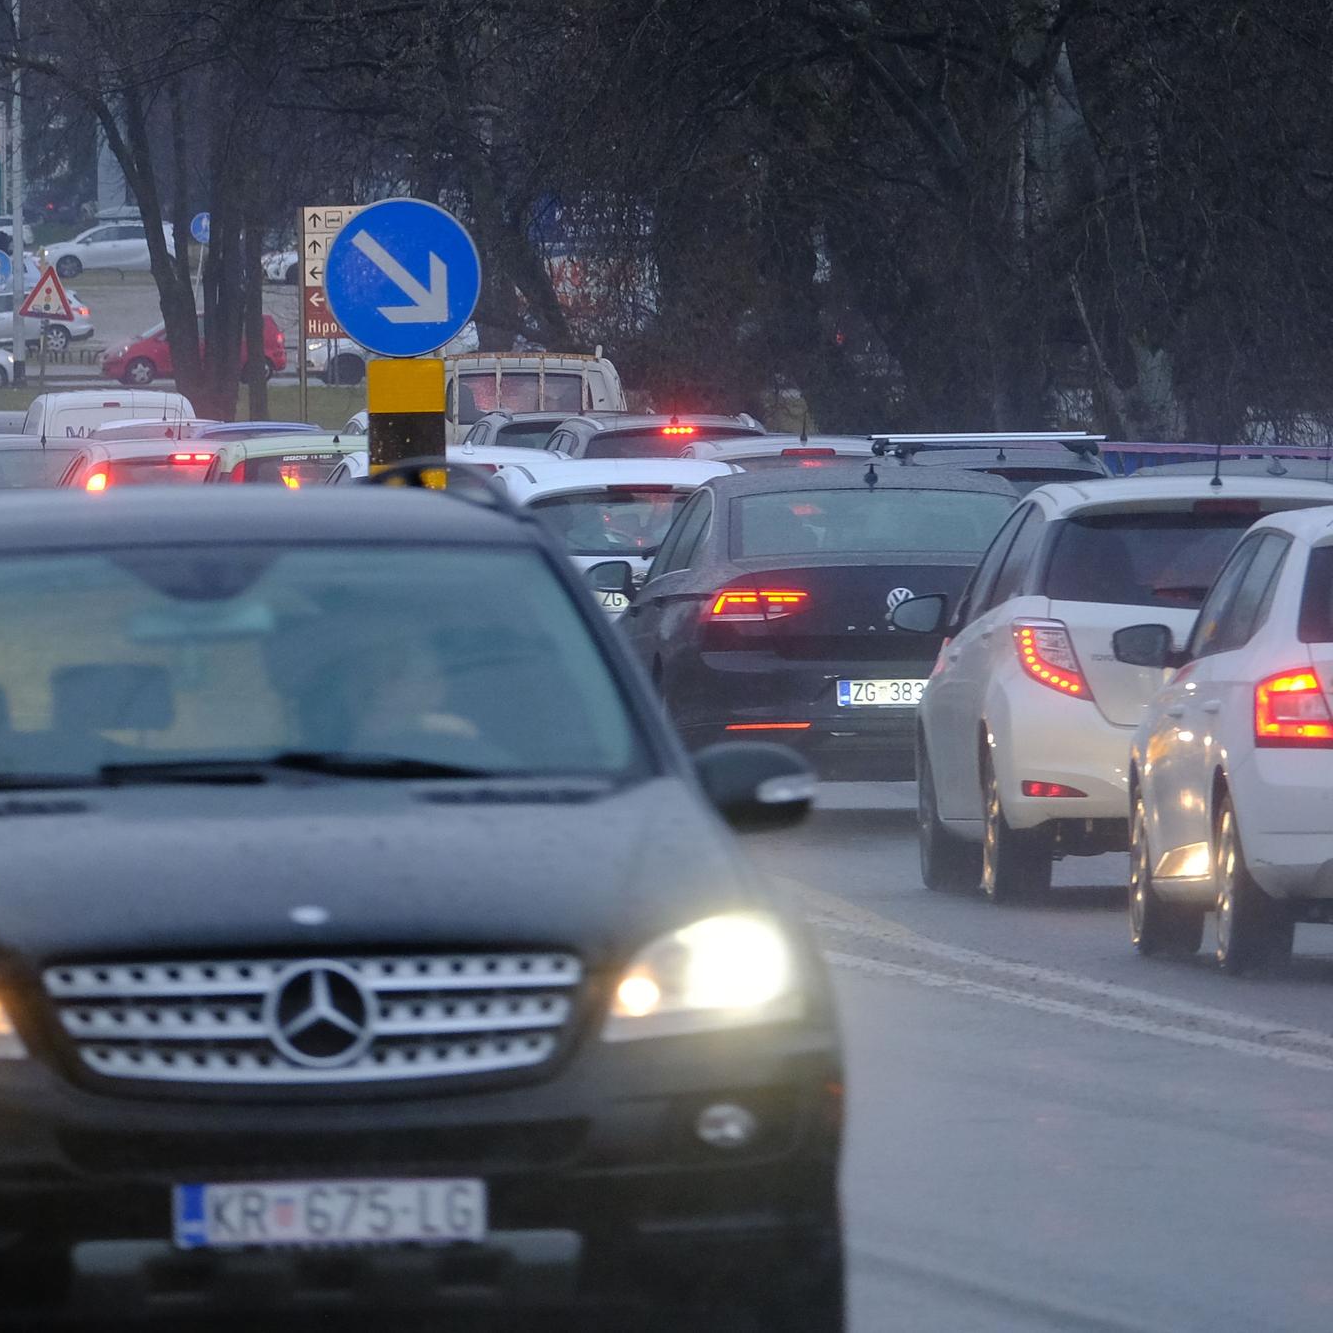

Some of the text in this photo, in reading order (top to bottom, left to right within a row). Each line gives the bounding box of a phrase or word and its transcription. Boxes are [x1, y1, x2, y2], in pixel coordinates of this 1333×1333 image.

[308, 319, 342, 337] Hipo
[602, 592, 623, 607] ZG
[852, 682, 925, 702] ZG 383
[210, 1185, 475, 1236] KR 675-LG
